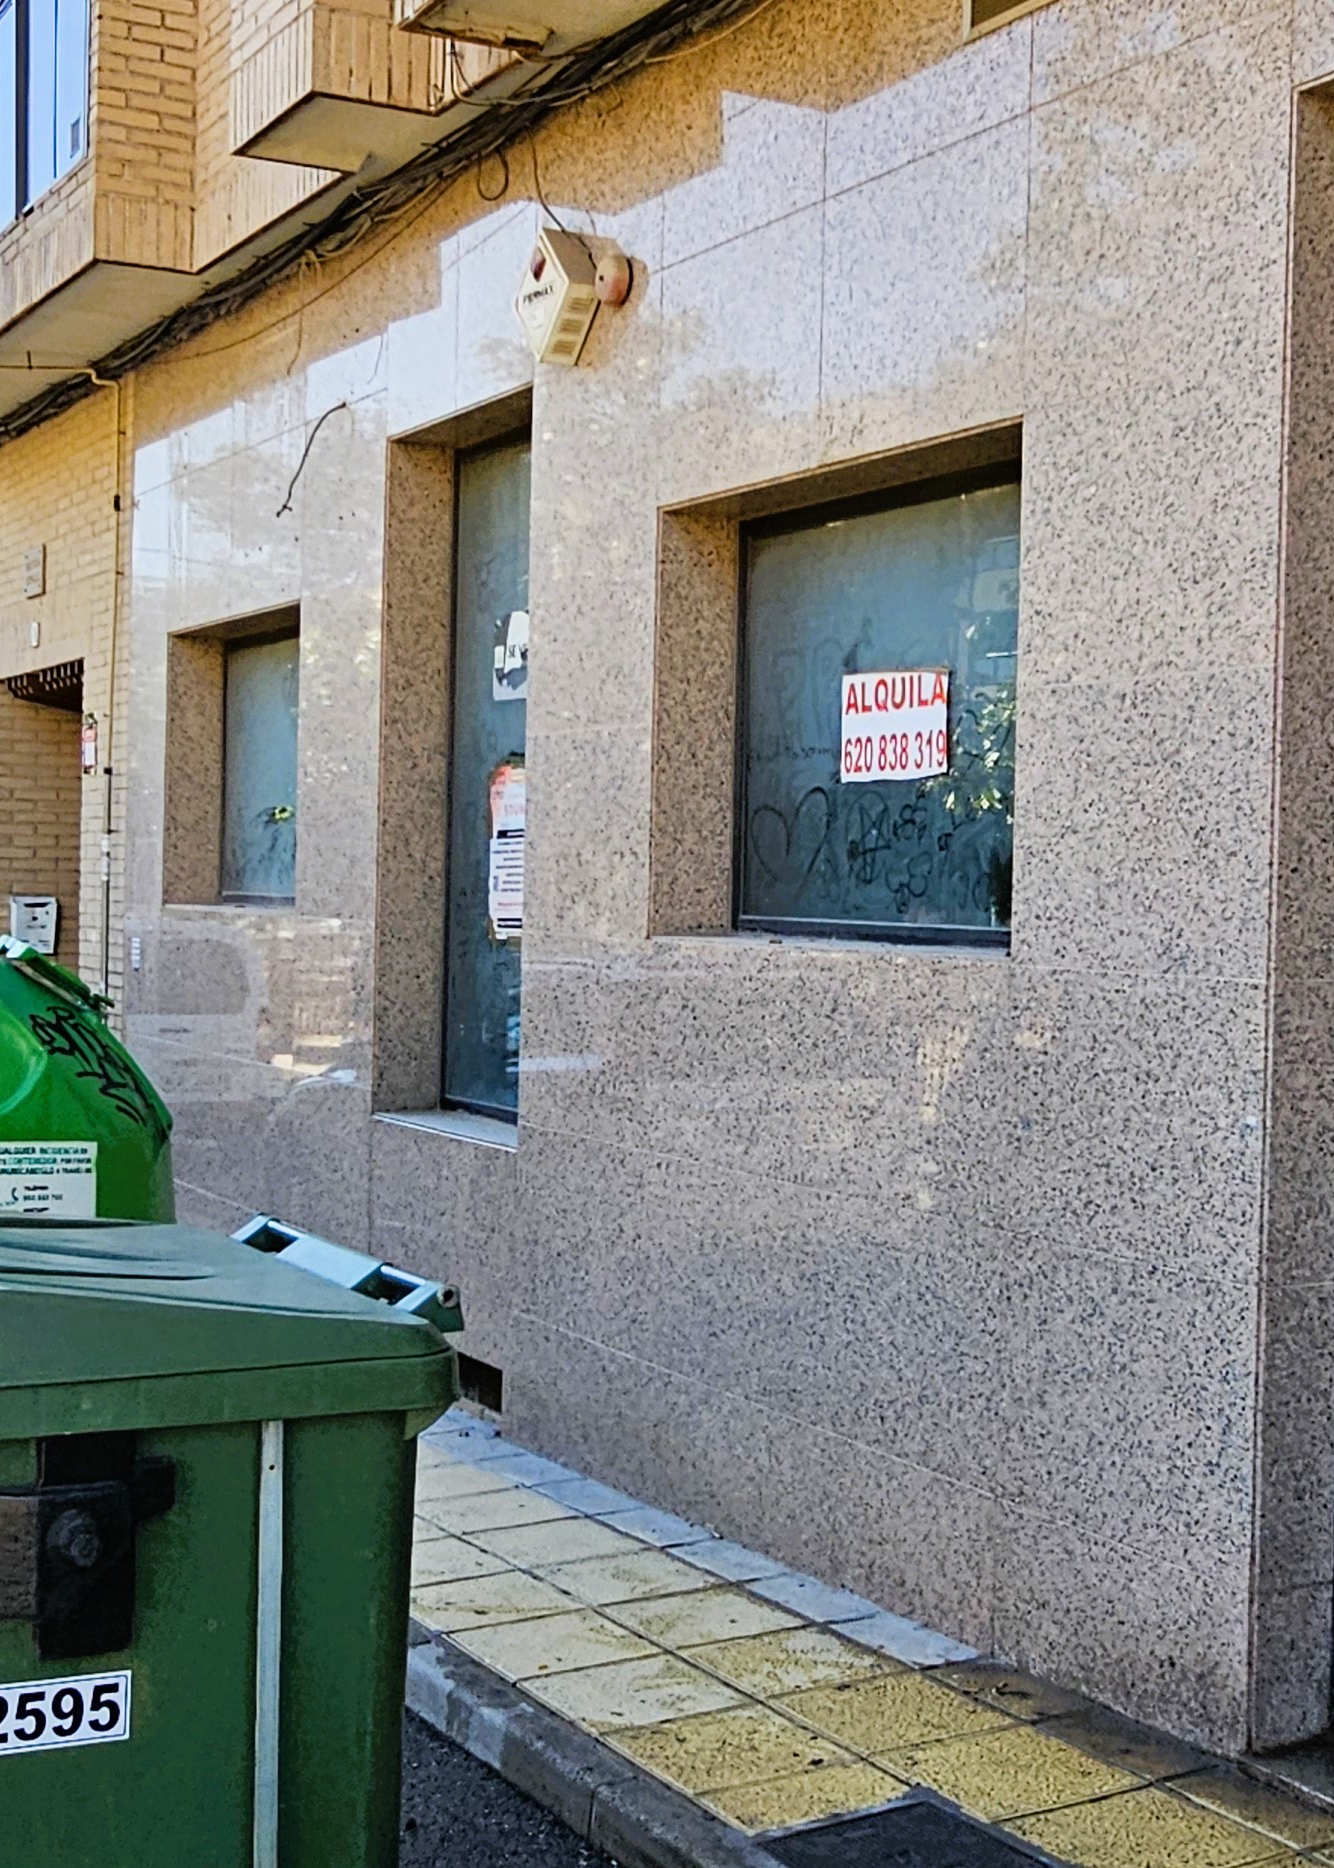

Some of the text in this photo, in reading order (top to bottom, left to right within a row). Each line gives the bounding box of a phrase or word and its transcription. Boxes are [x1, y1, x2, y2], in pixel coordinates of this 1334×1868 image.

[845, 672, 947, 715] ALQUILA
[844, 729, 947, 774] 620 838 319
